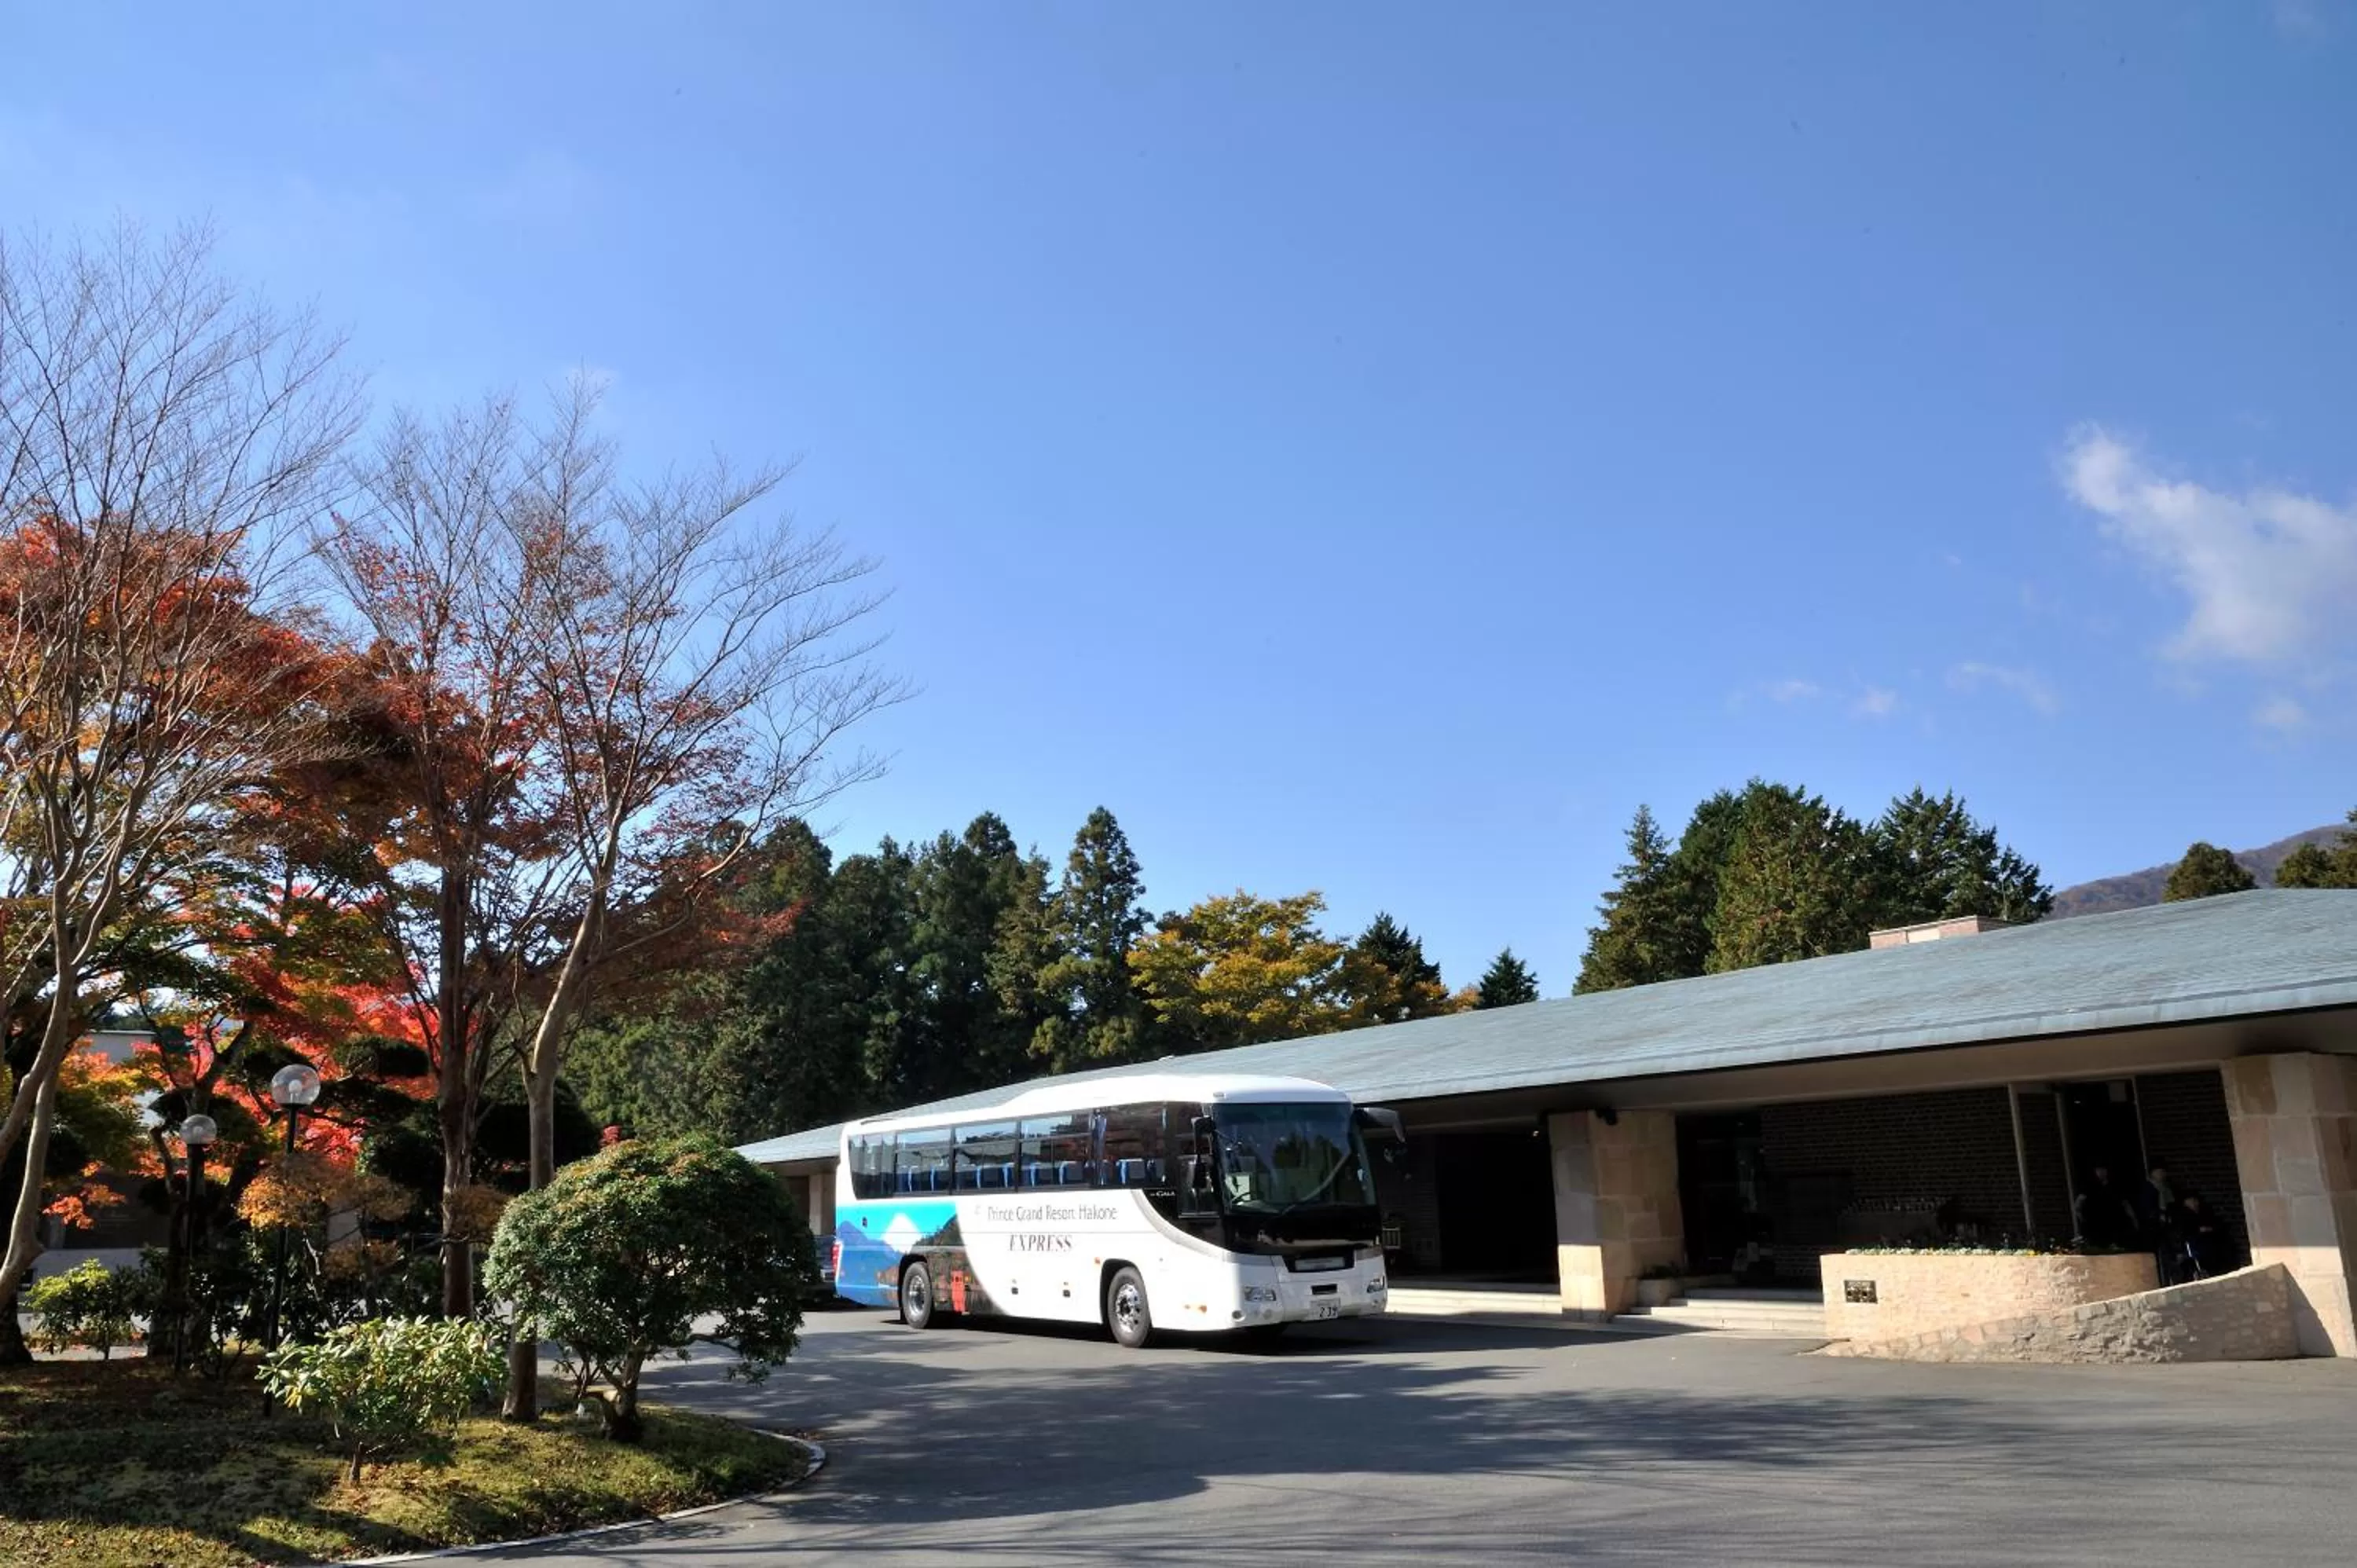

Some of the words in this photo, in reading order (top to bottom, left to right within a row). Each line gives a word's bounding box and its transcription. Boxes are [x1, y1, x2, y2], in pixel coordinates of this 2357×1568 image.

[988, 1206, 1014, 1221] Prince
[1016, 1206, 1043, 1221] Grand
[1045, 1204, 1076, 1220] Resort
[1079, 1203, 1118, 1220] Hakone
[1008, 1234, 1072, 1251] EXPRESS
